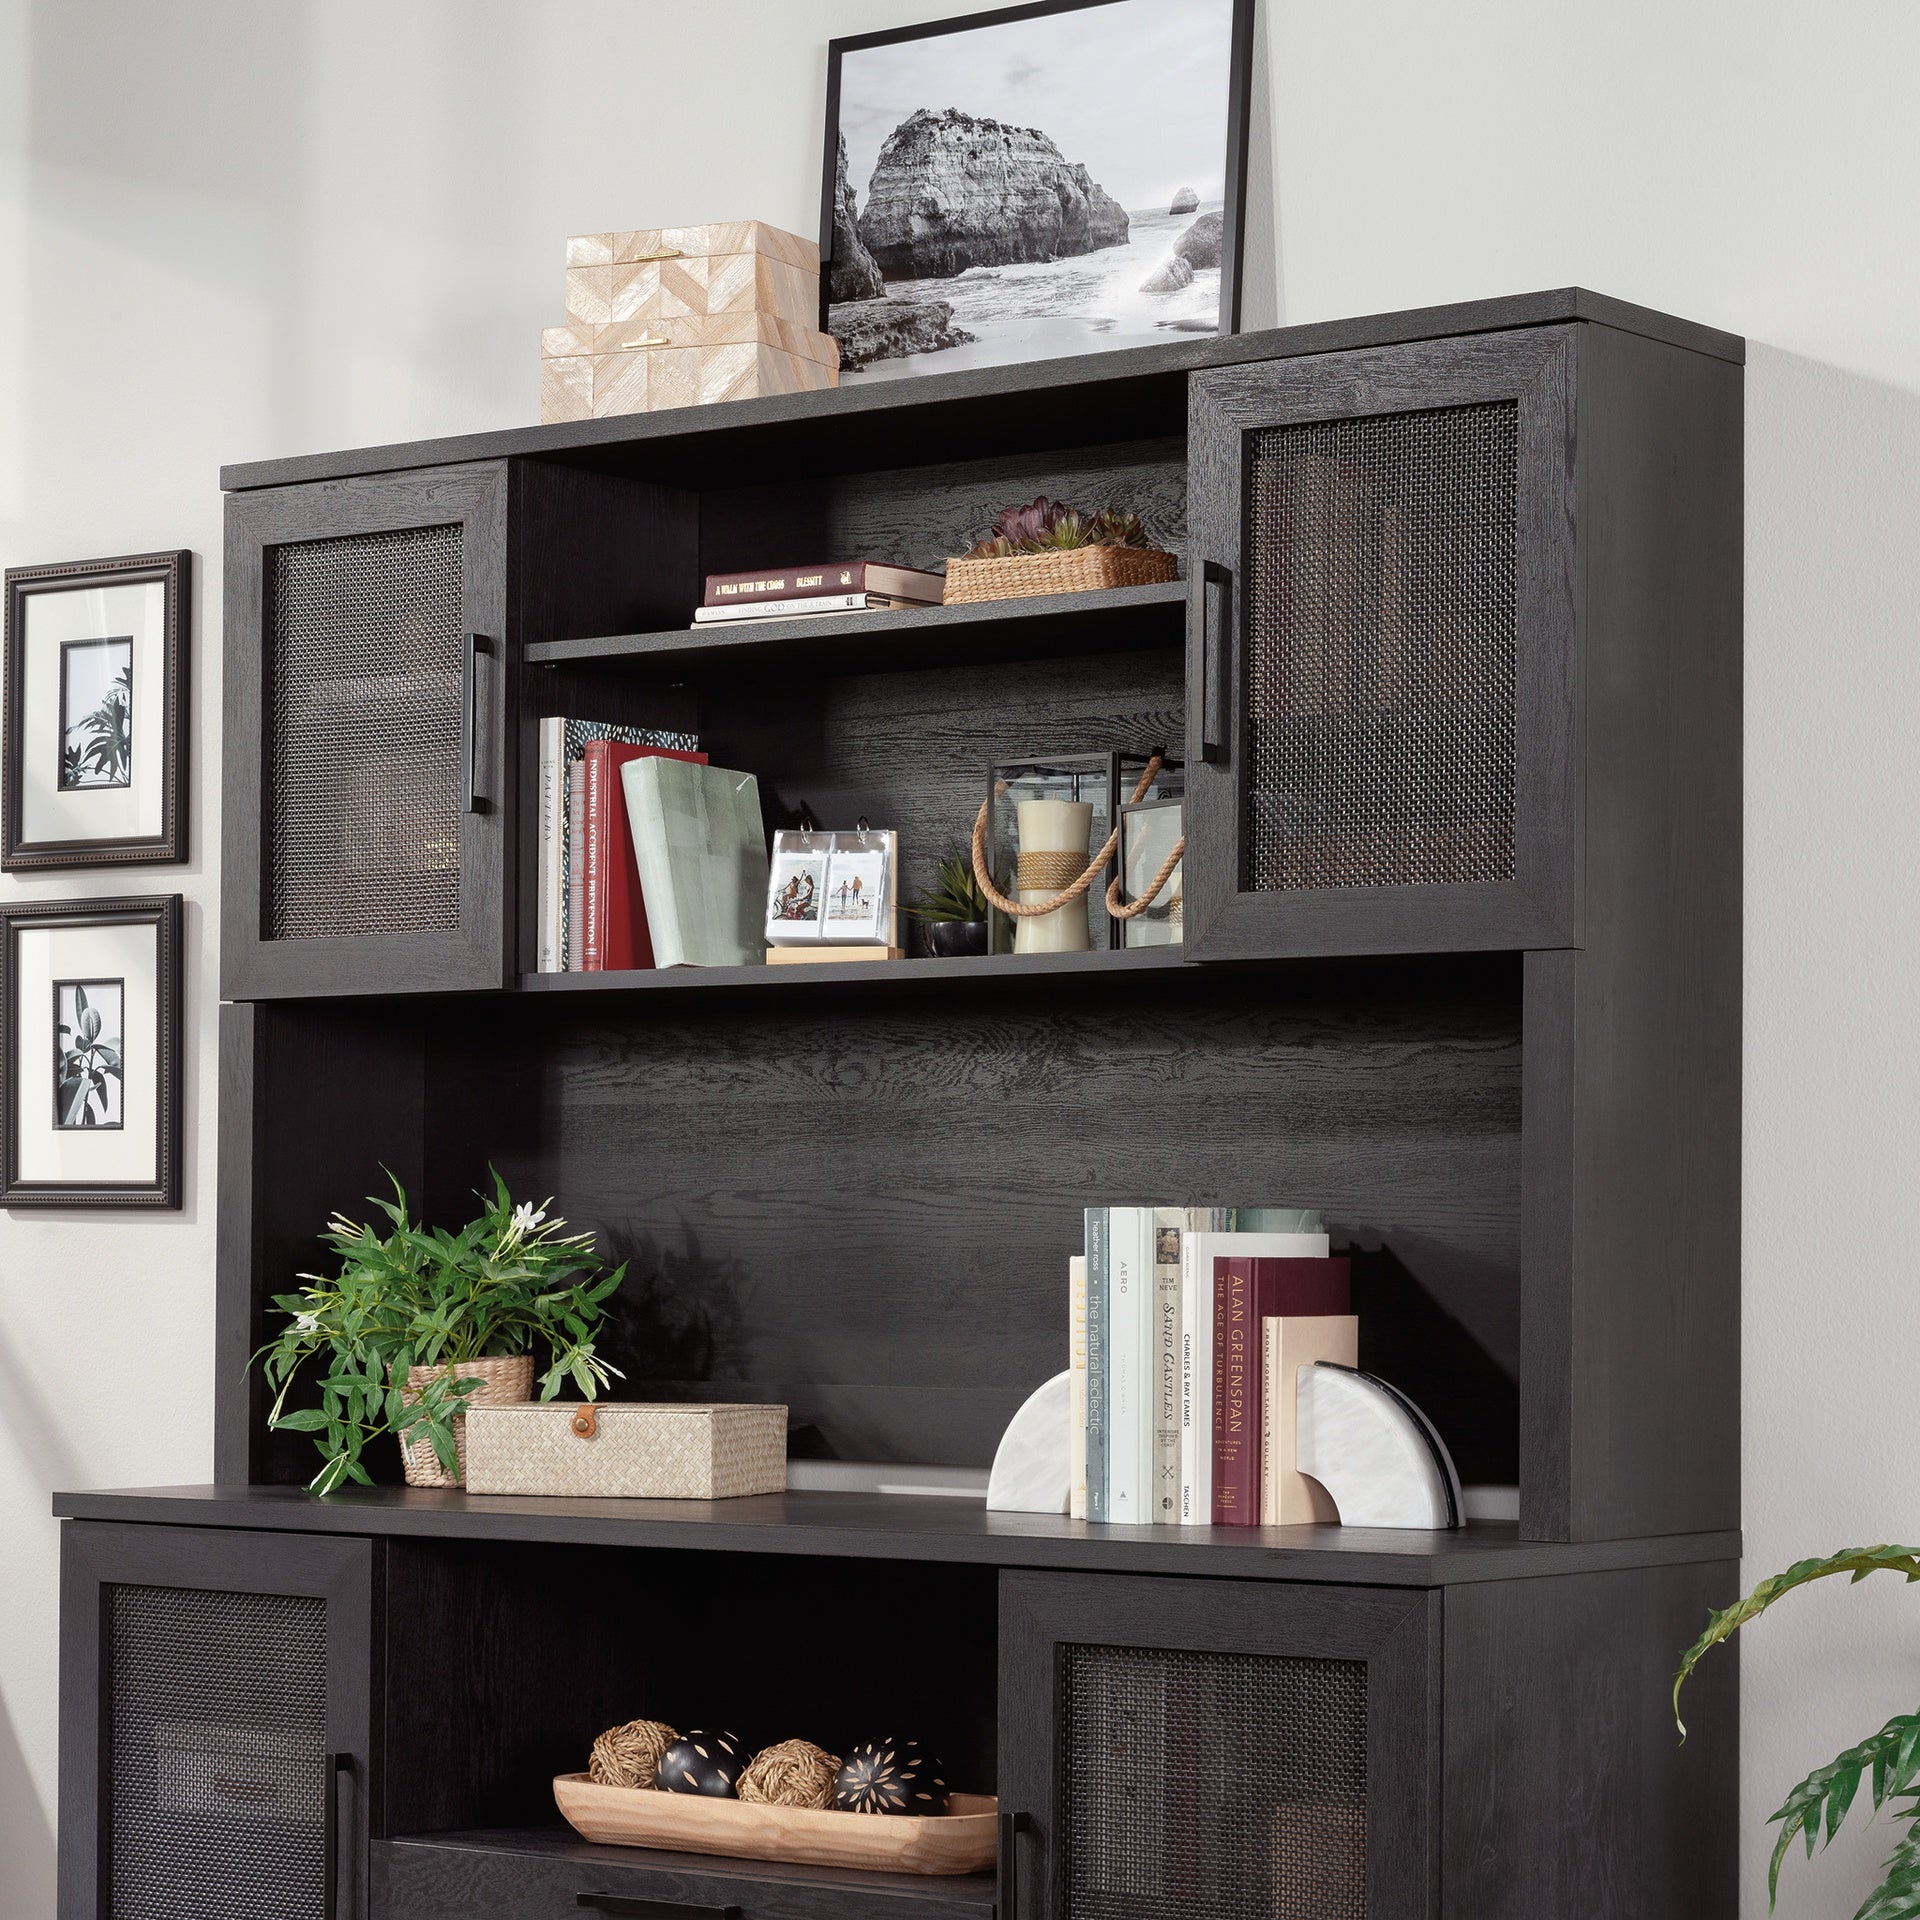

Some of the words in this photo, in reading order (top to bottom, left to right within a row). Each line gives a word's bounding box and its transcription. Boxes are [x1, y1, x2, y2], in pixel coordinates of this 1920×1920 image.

[716, 586, 721, 595] A
[721, 584, 738, 595] WALK
[739, 582, 754, 593] WITH
[755, 581, 766, 591] THE
[766, 579, 785, 590] CROSS
[763, 603, 785, 613] GOD
[544, 775, 552, 843] PATTERN
[589, 759, 598, 818] INDUSTRIAL
[588, 824, 597, 876] ACCIDENT
[587, 880, 596, 944] PREVENTION
[1092, 1221, 1100, 1252] heather
[1120, 1261, 1128, 1294] AERO
[1217, 1276, 1225, 1298] THE
[1231, 1275, 1244, 1321] ALAN
[1089, 1295, 1102, 1320] the
[1162, 1302, 1175, 1348] SAND
[1217, 1304, 1225, 1327] AGE
[1089, 1324, 1103, 1374] natural
[1183, 1333, 1191, 1371] CHARLES
[1216, 1332, 1224, 1347] OF
[1162, 1352, 1175, 1420] CASTLES
[1183, 1381, 1191, 1397] RAY
[1215, 1353, 1224, 1431] TURBULENCE
[1230, 1329, 1244, 1432] GREENSPAN
[1089, 1378, 1103, 1435] eclectic
